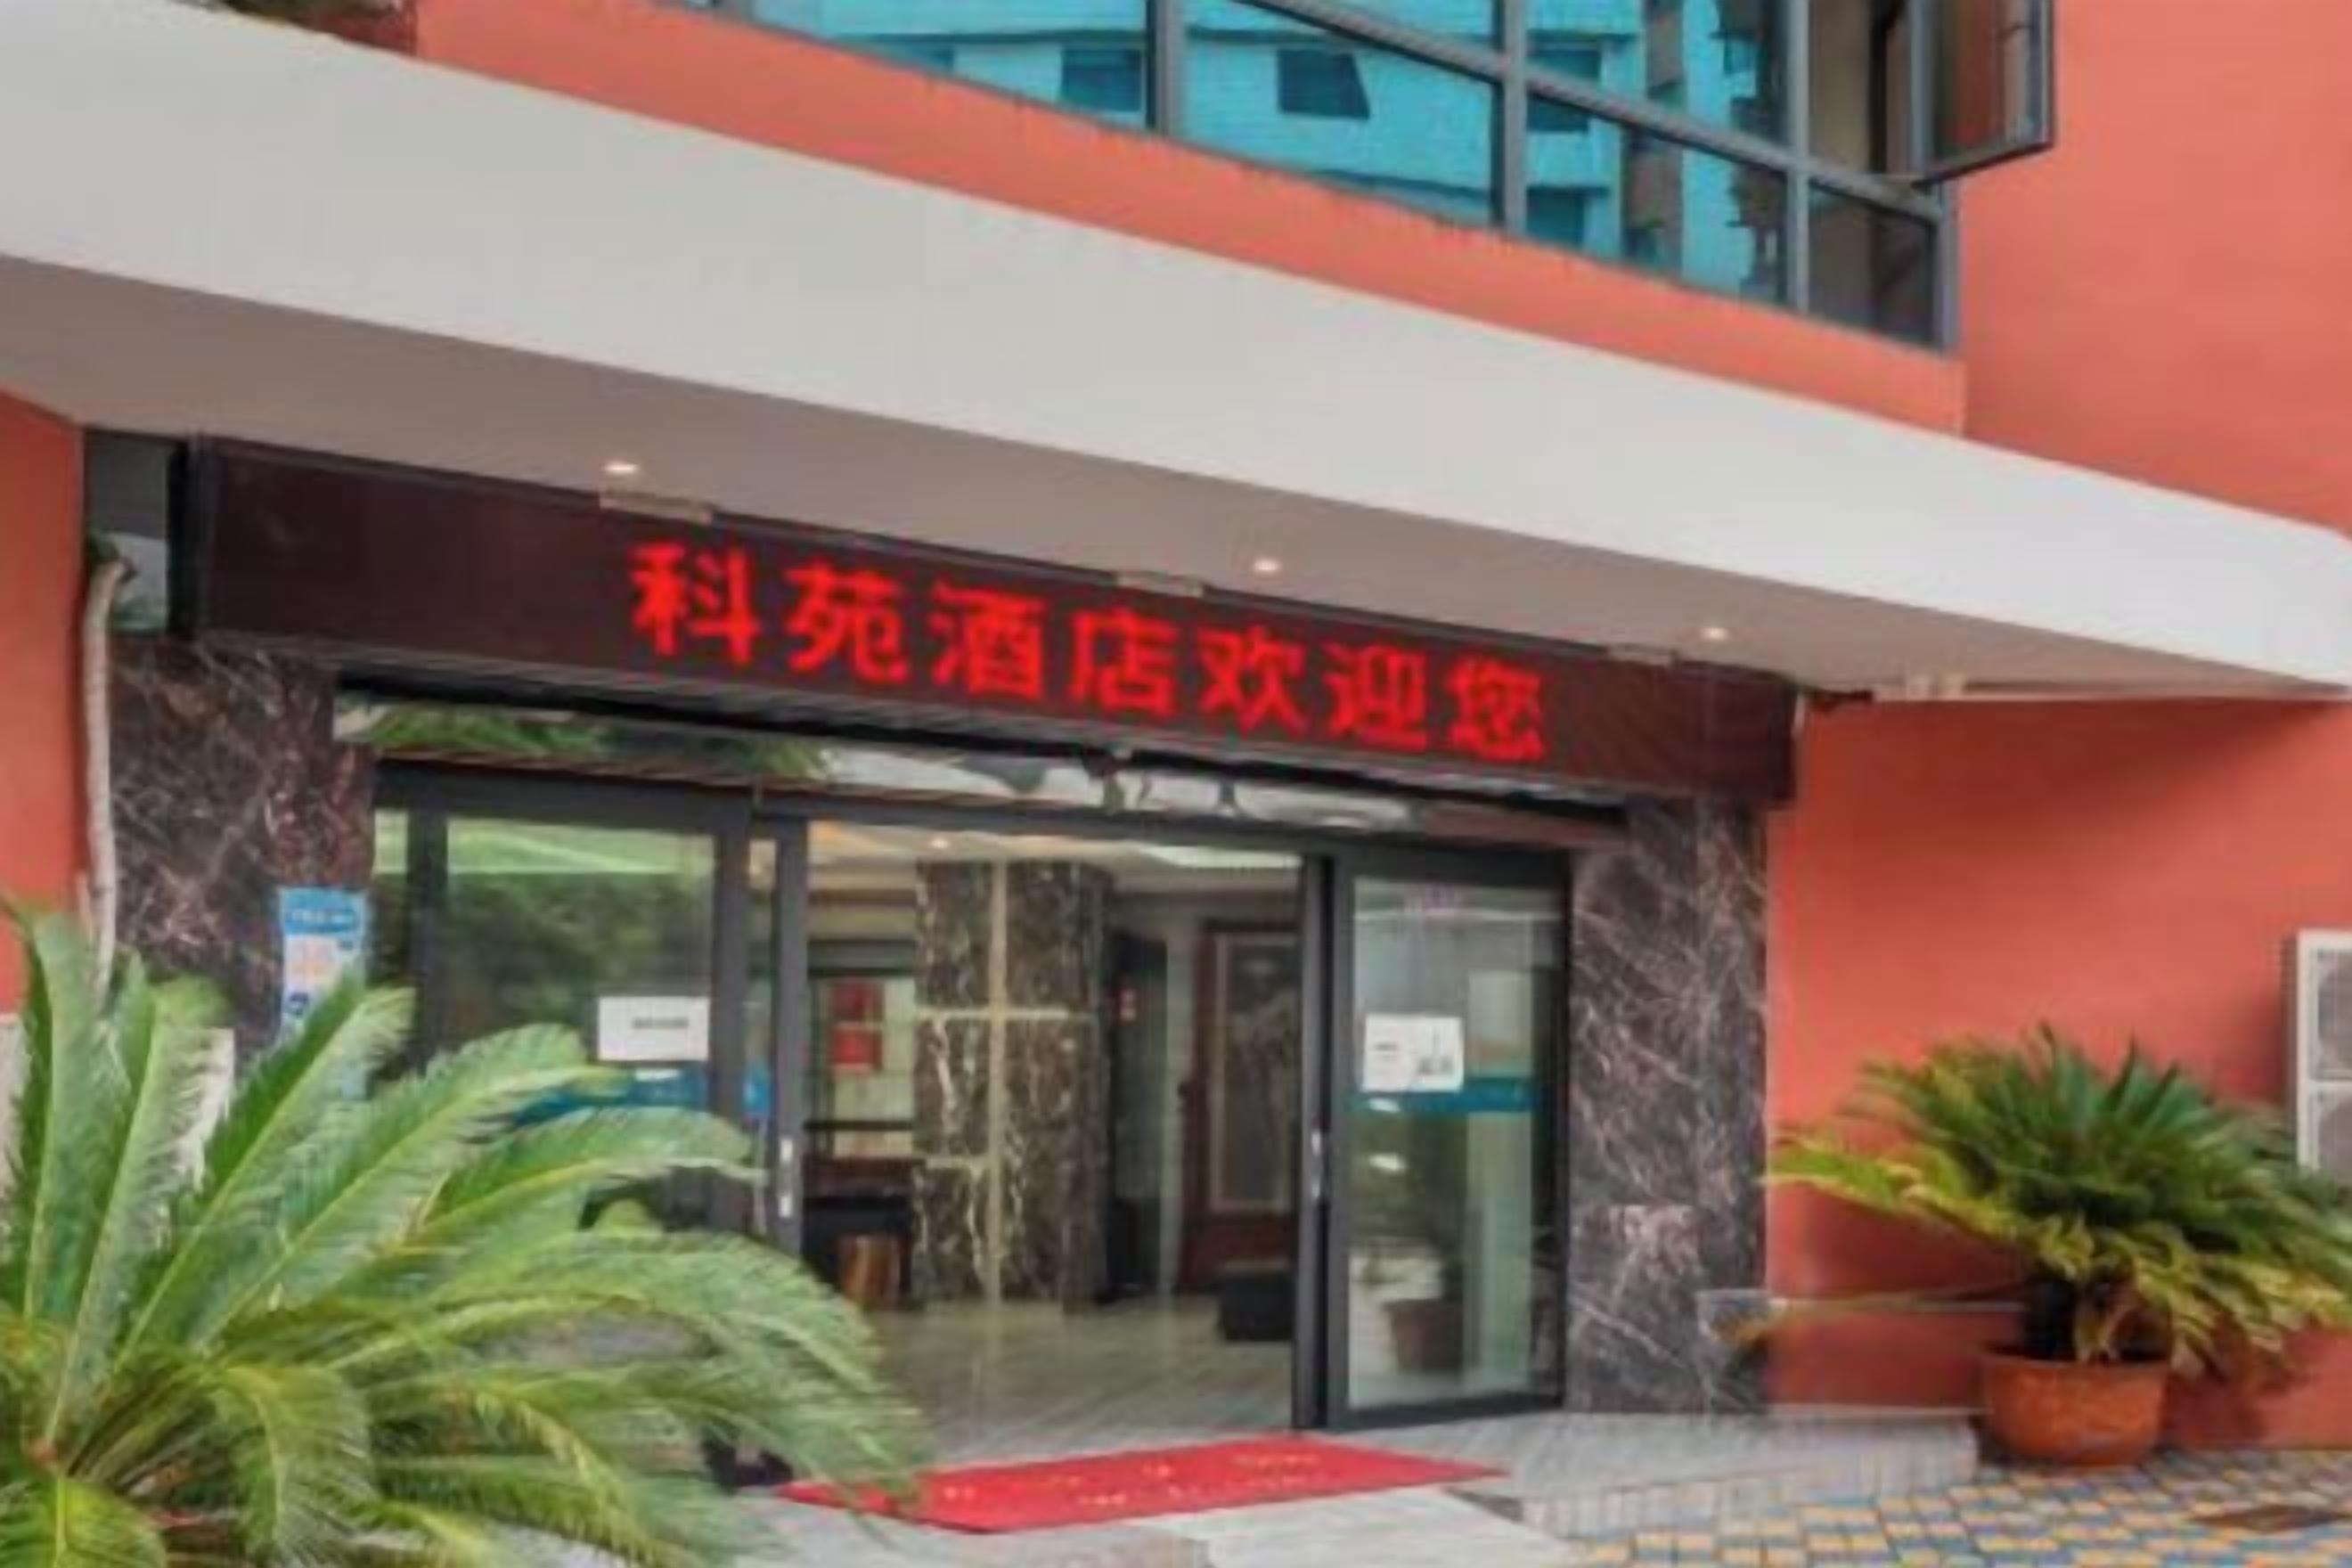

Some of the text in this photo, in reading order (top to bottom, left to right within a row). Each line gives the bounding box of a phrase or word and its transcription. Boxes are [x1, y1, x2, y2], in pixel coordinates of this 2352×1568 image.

[629, 541, 1547, 763] 科苑酒店欢迎您
